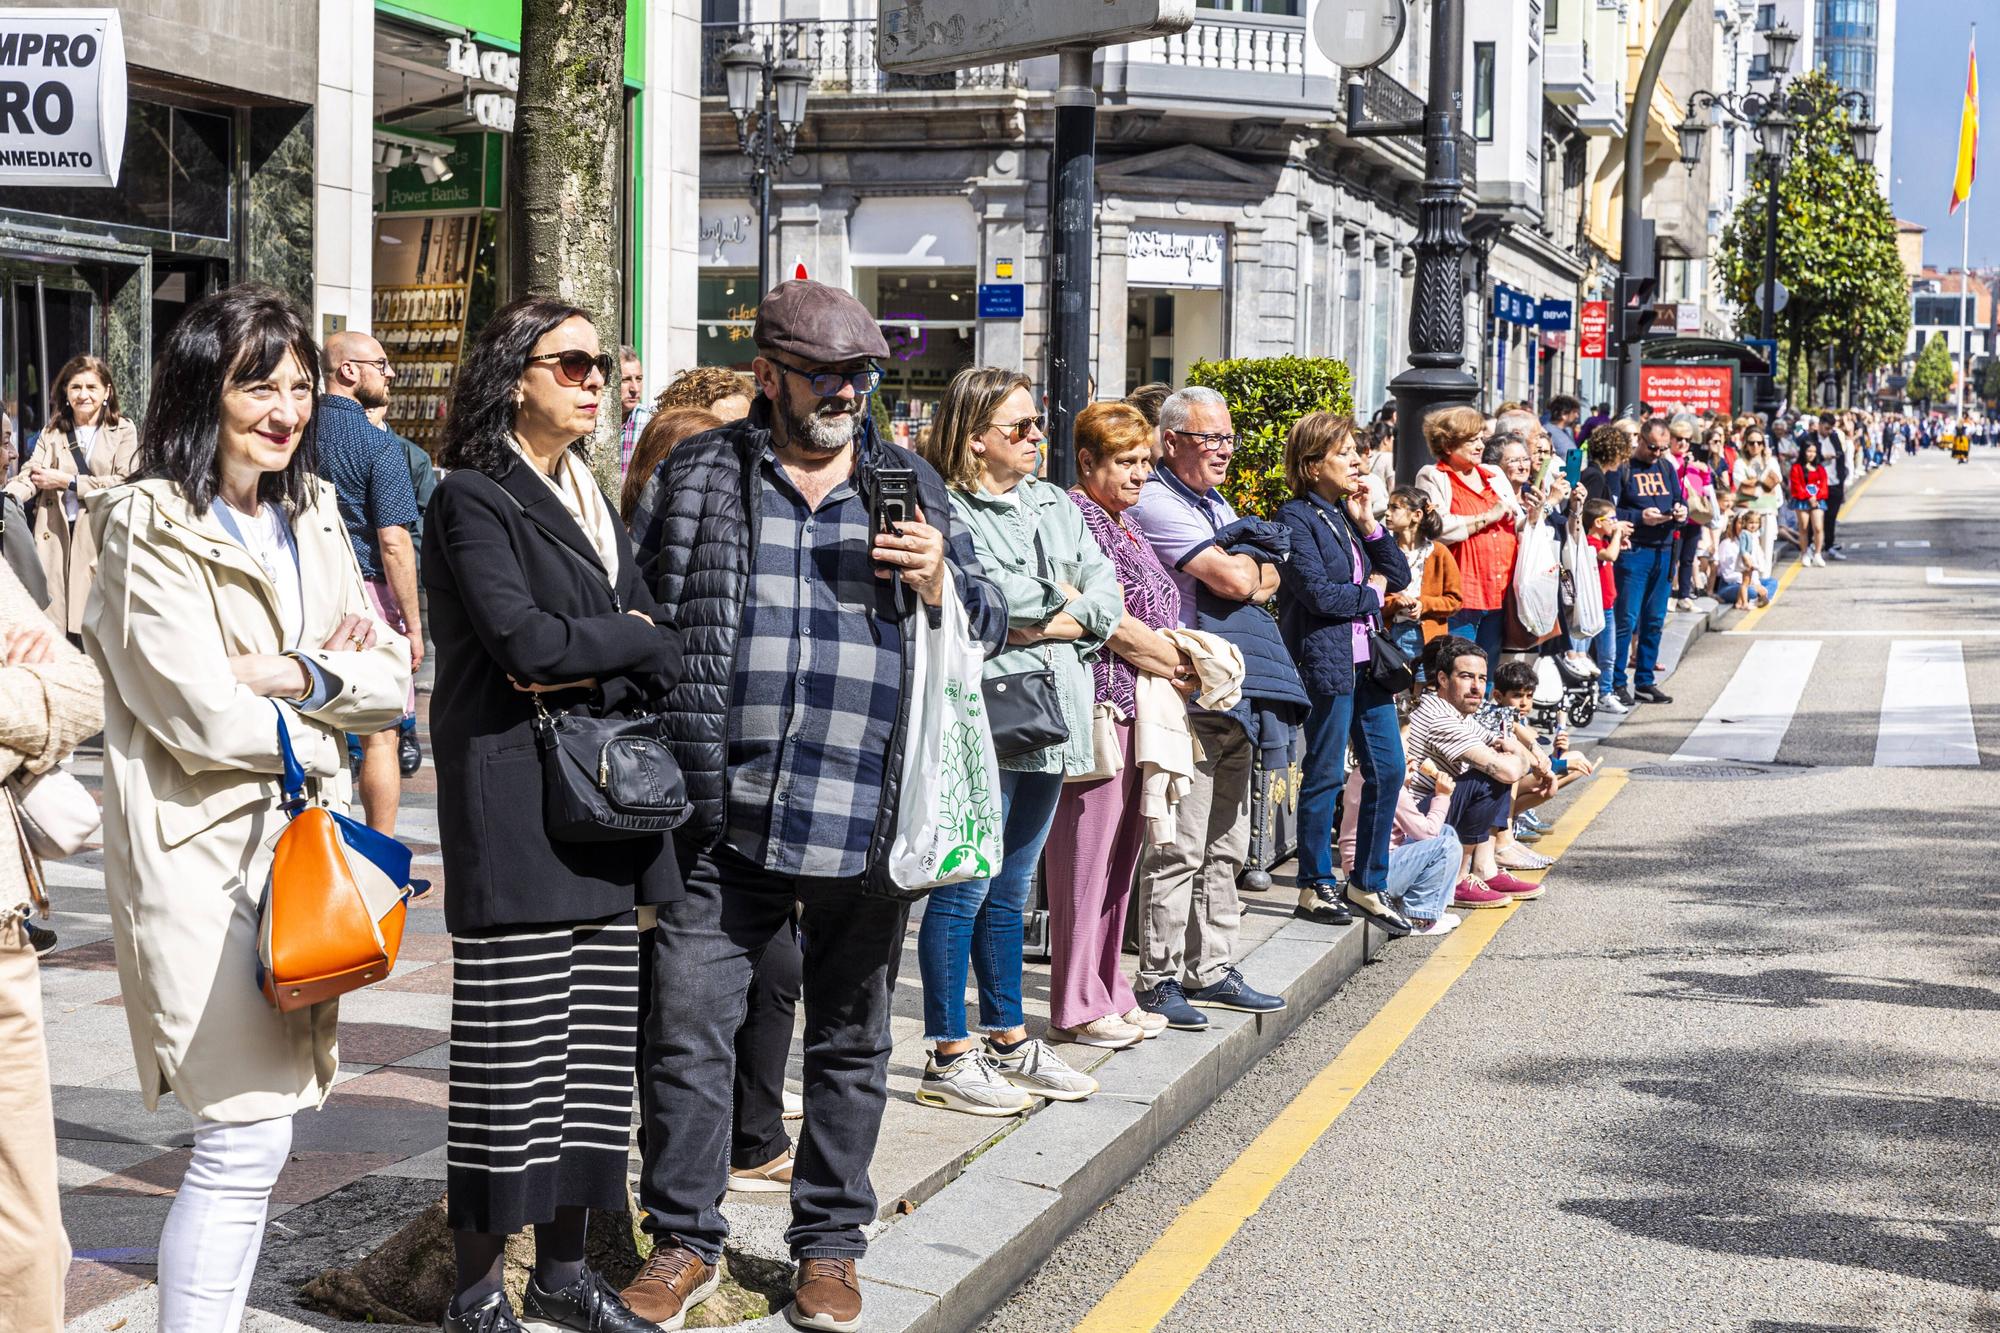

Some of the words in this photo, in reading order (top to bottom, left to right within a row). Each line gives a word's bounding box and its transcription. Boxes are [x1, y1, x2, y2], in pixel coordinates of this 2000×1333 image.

[0, 80, 74, 136] RO
[391, 189, 430, 204] Power
[431, 186, 470, 201] Banks
[1543, 311, 1568, 319] BBVA
[1647, 376, 1686, 386] Cuando
[1686, 377, 1696, 386] la
[1697, 377, 1721, 387] sidra
[1647, 388, 1657, 397] le
[1658, 388, 1682, 397] hace
[1633, 473, 1670, 497] RH
